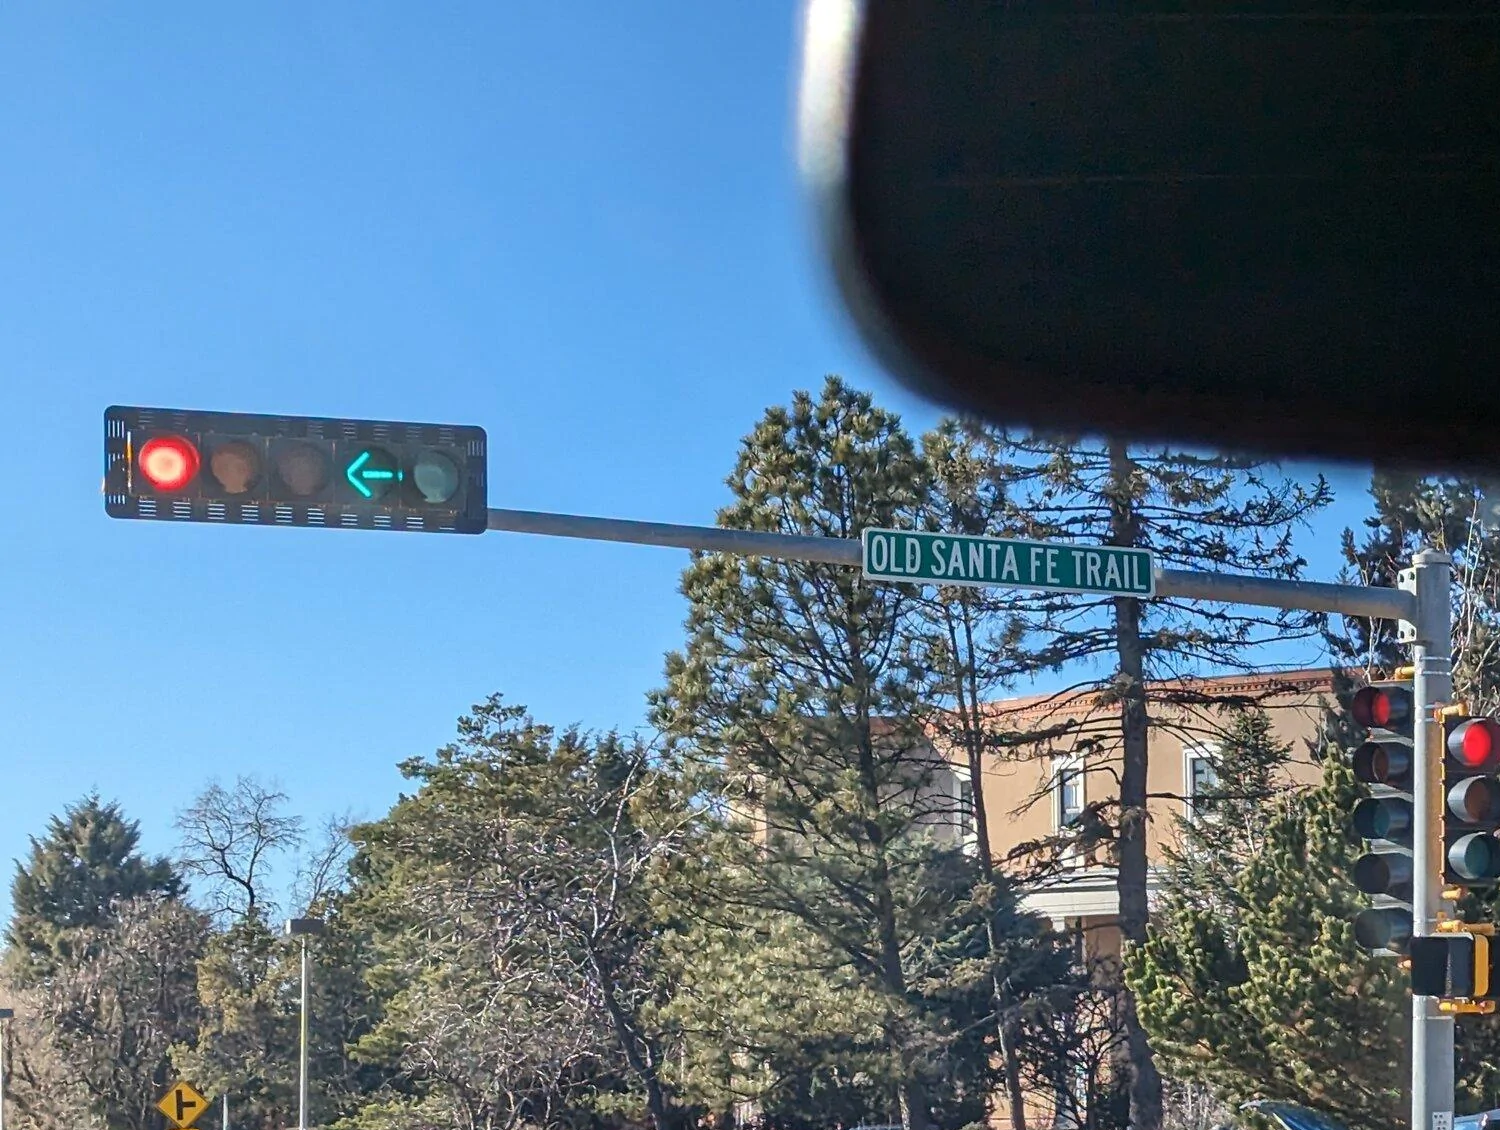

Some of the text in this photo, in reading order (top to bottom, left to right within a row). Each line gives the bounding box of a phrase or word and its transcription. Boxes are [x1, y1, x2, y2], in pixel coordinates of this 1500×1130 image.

[871, 535, 1147, 590] OLD SANTA FE TRAIL
